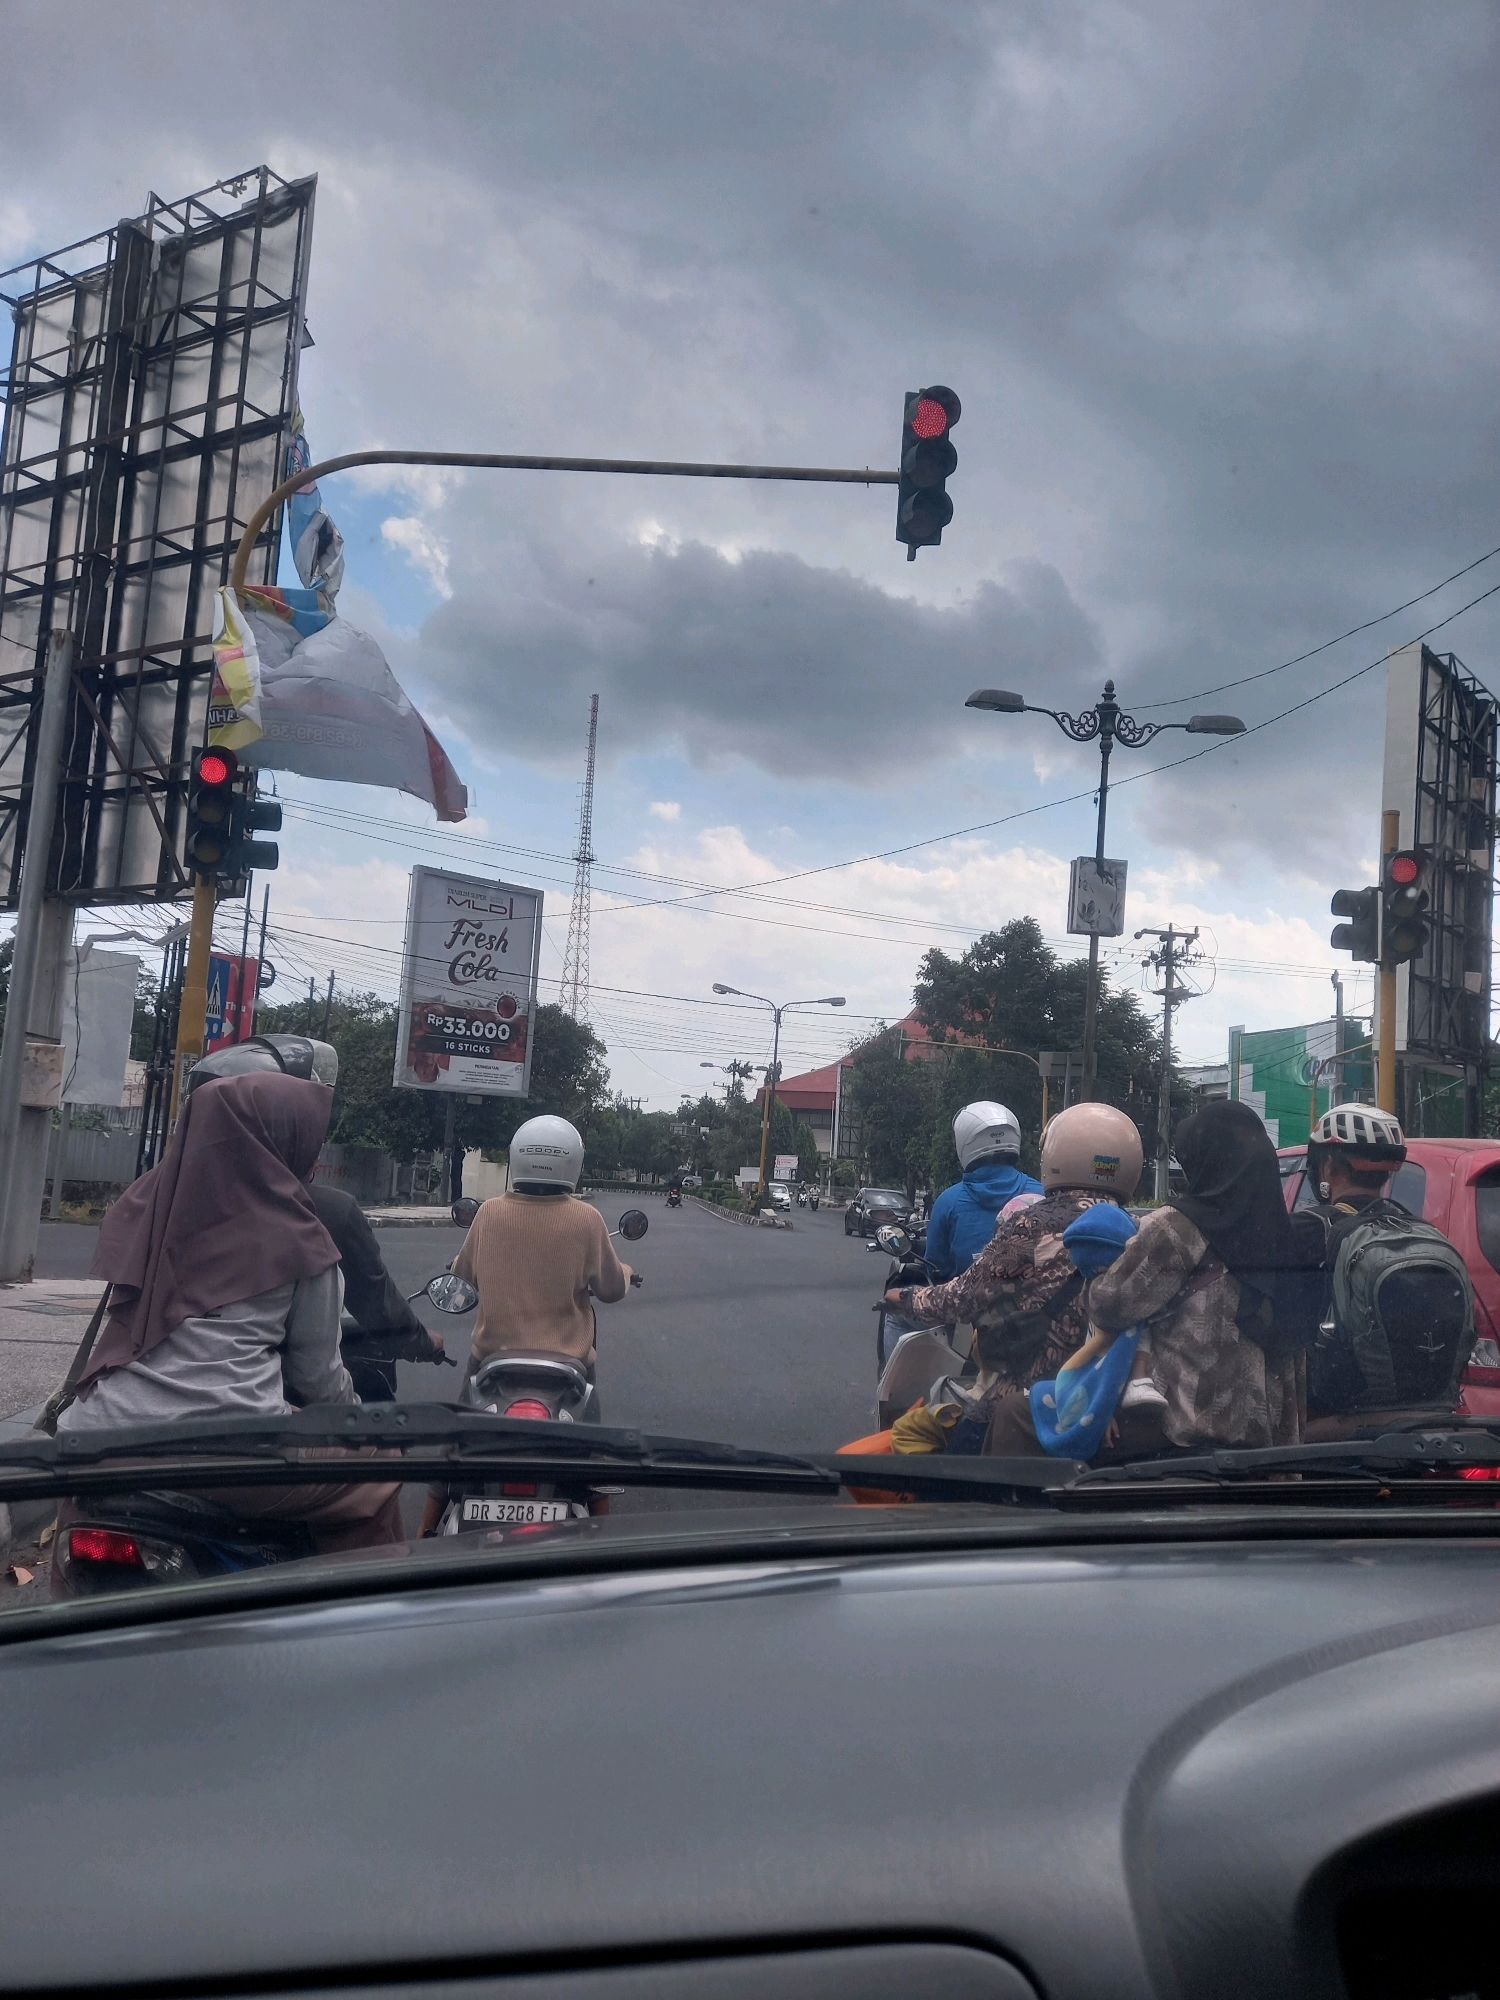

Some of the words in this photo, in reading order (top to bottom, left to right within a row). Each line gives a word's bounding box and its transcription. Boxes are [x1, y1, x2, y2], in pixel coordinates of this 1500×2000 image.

[443, 917, 508, 954] Fresh
[447, 950, 500, 986] Cola
[225, 1001, 246, 1013] Thu
[427, 1013, 510, 1041] Rp33.000
[445, 1041, 455, 1050] 16
[457, 1043, 491, 1054] STICKS
[518, 1147, 570, 1156] SCOOPY
[470, 1503, 490, 1520] DR
[496, 1504, 534, 1522] 3208
